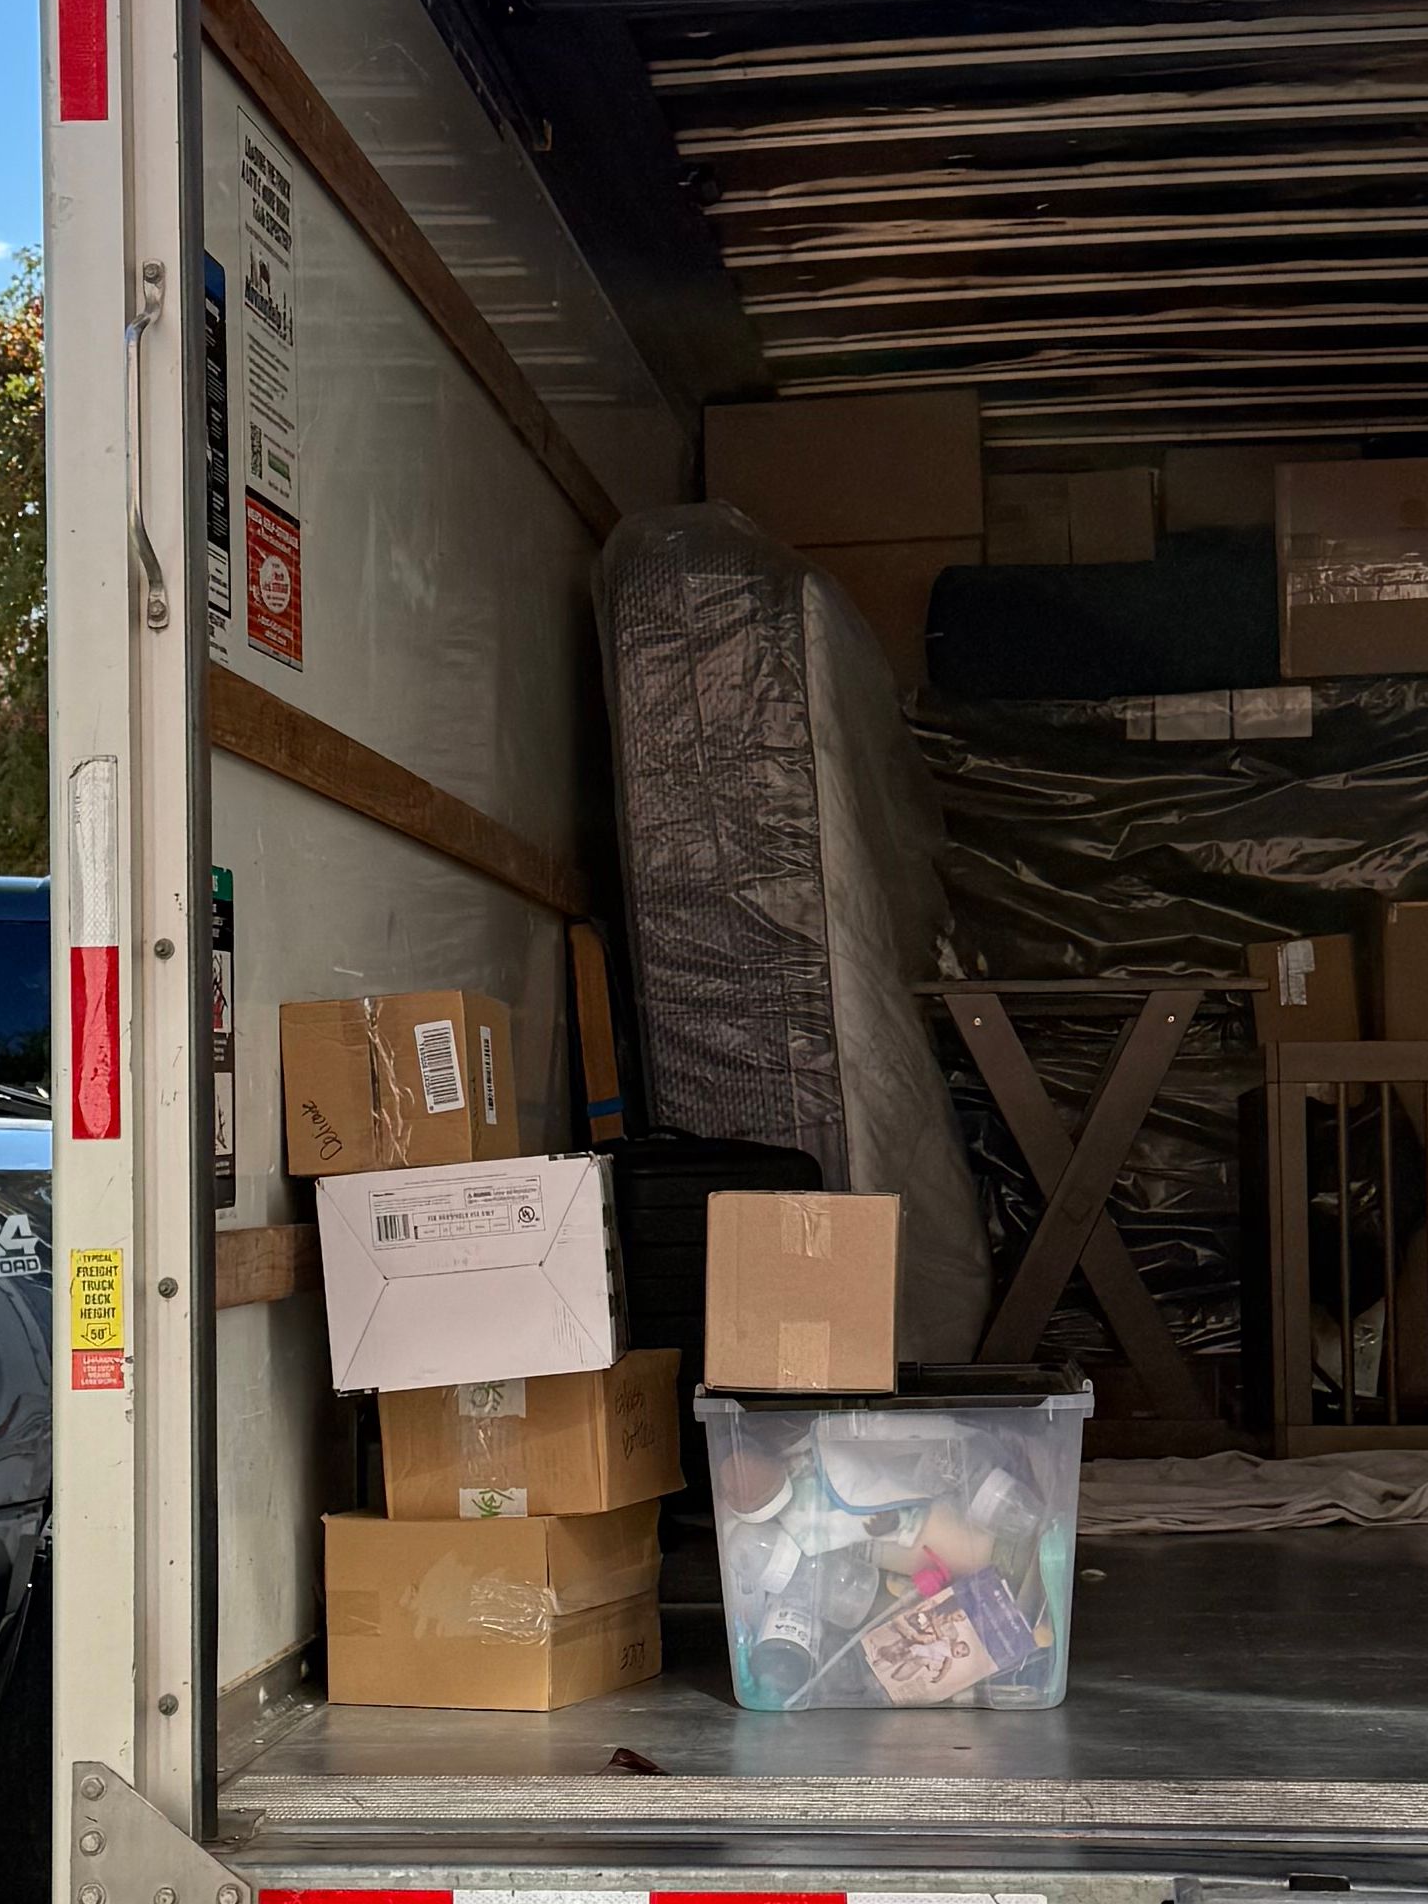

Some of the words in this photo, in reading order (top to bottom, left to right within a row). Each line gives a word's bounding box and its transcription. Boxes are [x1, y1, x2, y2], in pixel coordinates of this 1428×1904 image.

[83, 1254, 112, 1263] TYPICAL
[76, 1265, 119, 1278] FREIGHT
[81, 1279, 114, 1291] TRUCK
[84, 1294, 111, 1305] DECK
[80, 1307, 116, 1319] HEIGHT
